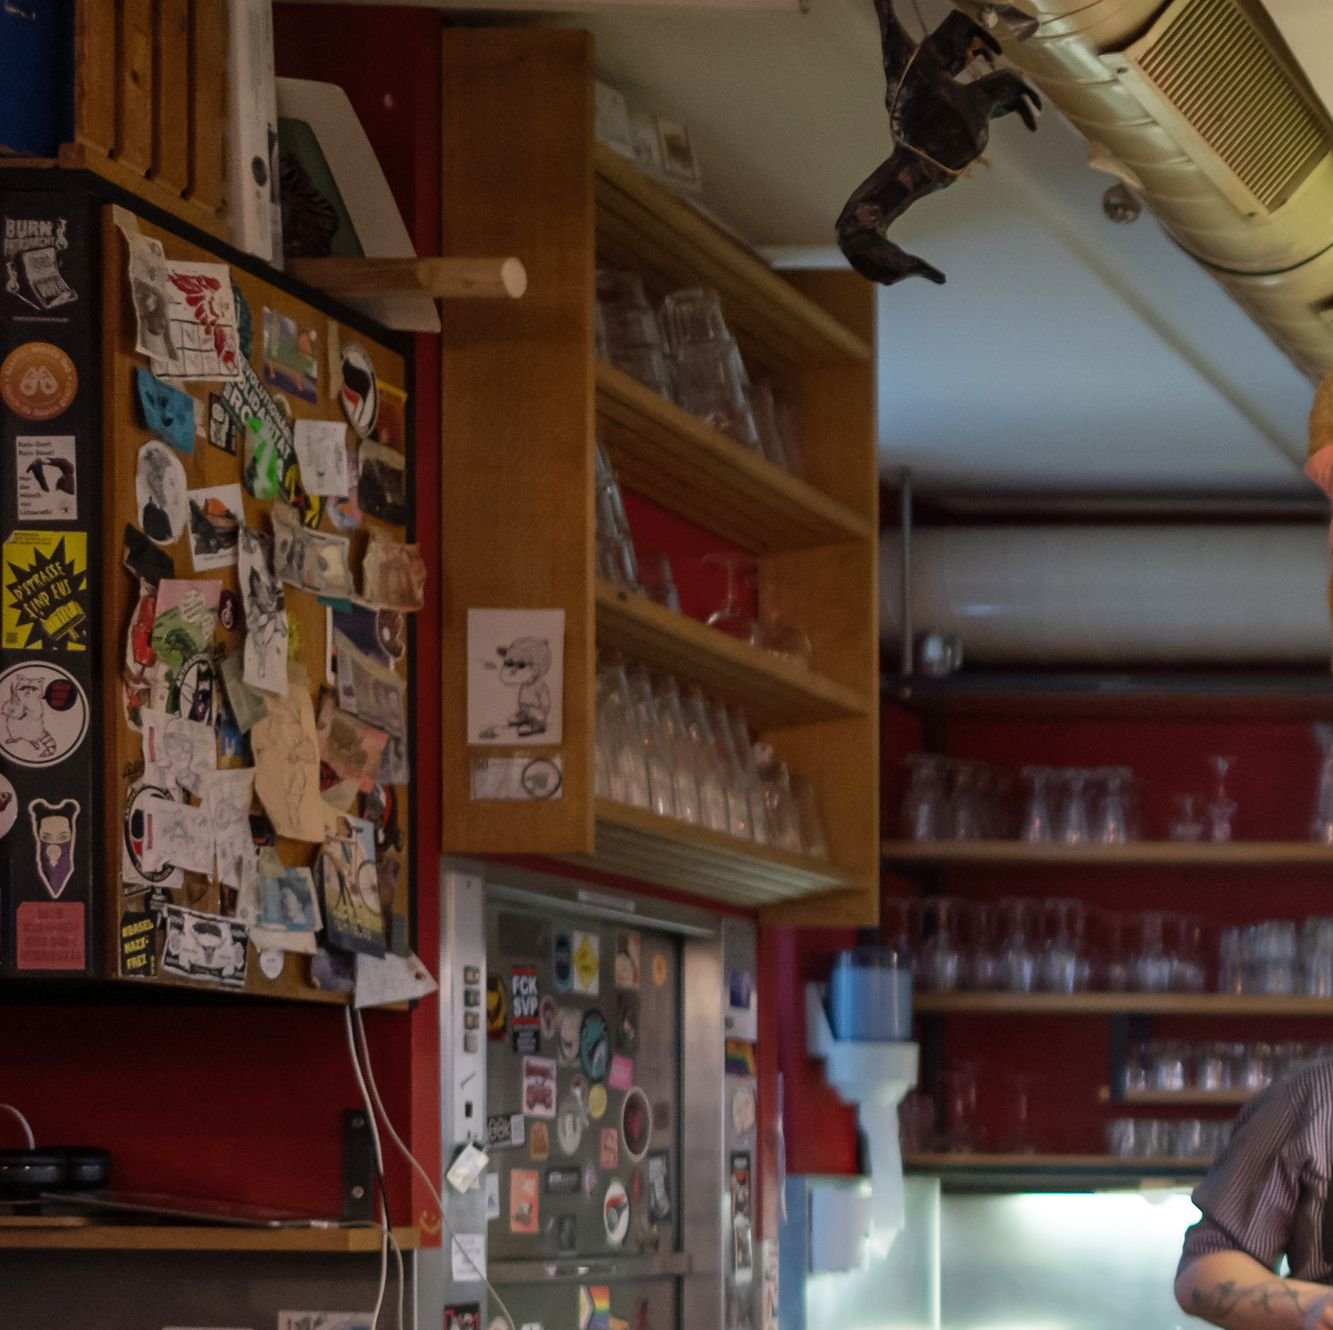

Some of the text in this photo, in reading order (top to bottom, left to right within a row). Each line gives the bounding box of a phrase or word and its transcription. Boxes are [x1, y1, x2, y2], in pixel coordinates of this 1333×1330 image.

[5, 218, 53, 238] BURN
[512, 975, 538, 995] FCK
[513, 996, 538, 1017] SVP
